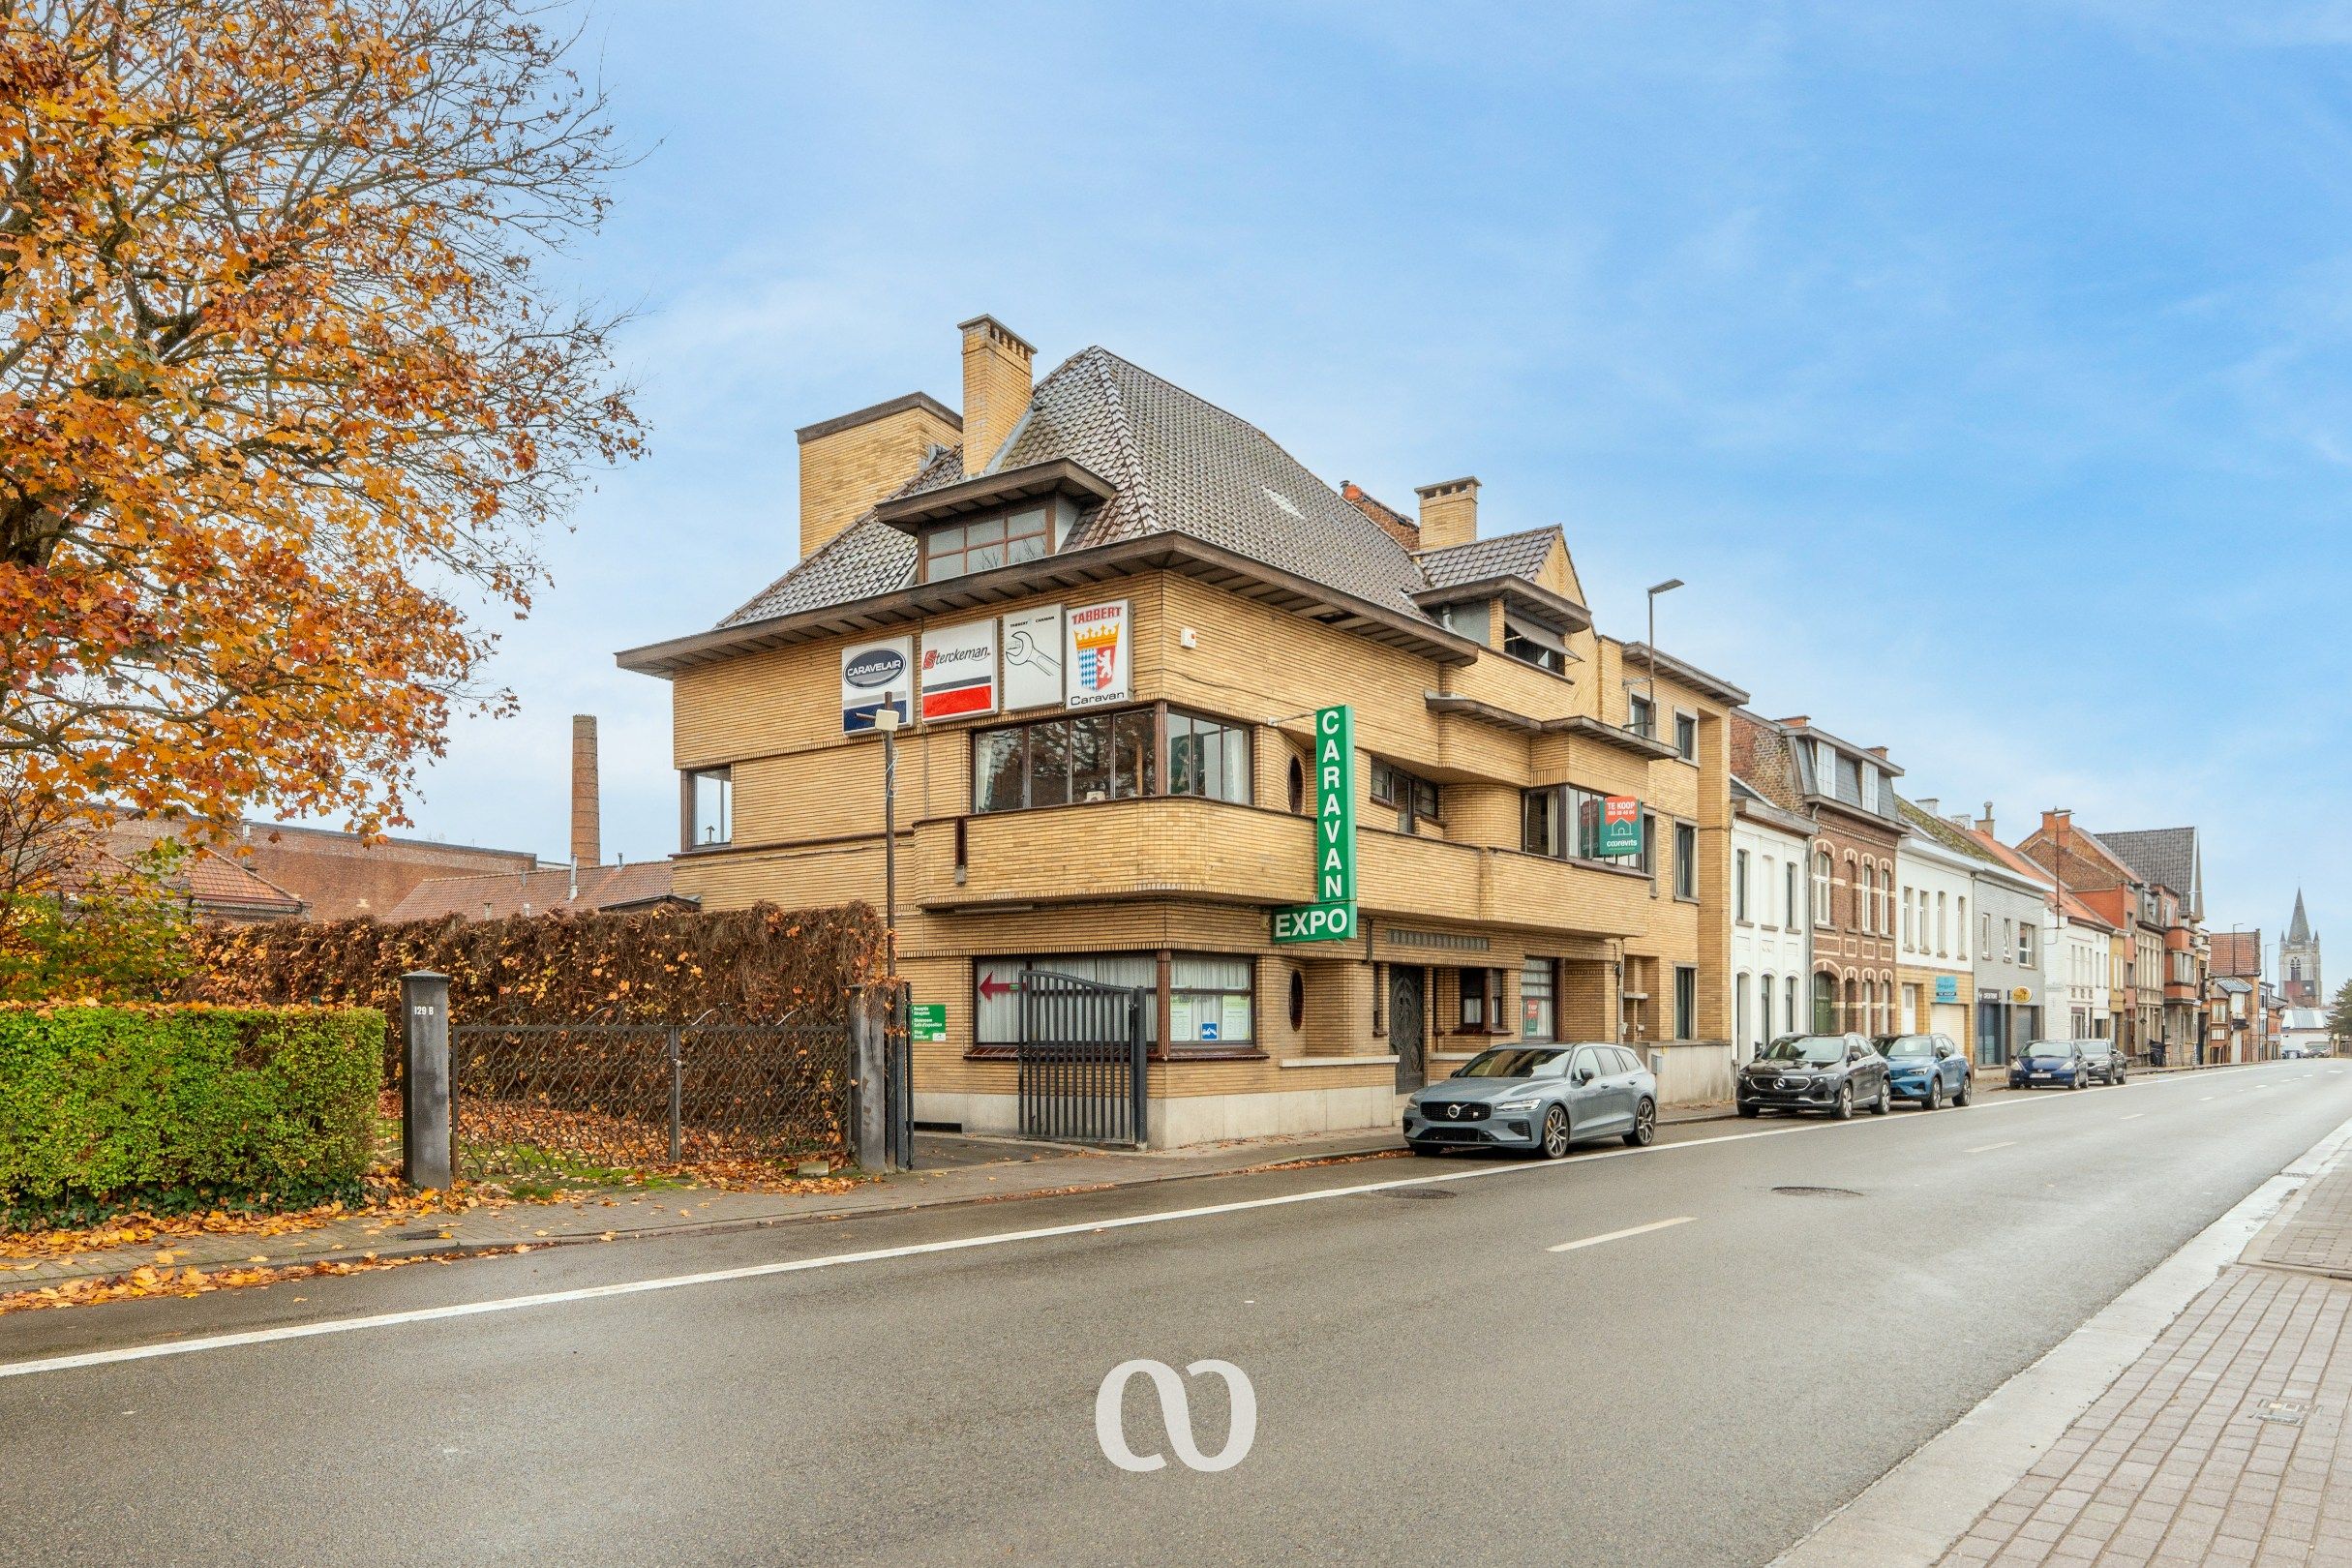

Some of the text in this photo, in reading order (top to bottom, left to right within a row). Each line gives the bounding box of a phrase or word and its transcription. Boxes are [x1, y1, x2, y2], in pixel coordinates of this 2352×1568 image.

[1072, 607, 1121, 624] TABBERT
[922, 647, 987, 670] Sterckeman
[847, 660, 901, 677] CARAVELAIR
[1070, 692, 1125, 706] Caravan
[1321, 710, 1342, 898] CARAVAN
[1607, 801, 1636, 810] TE KOOP
[1275, 908, 1348, 938] EXPO
[414, 1006, 434, 1015] 129 B
